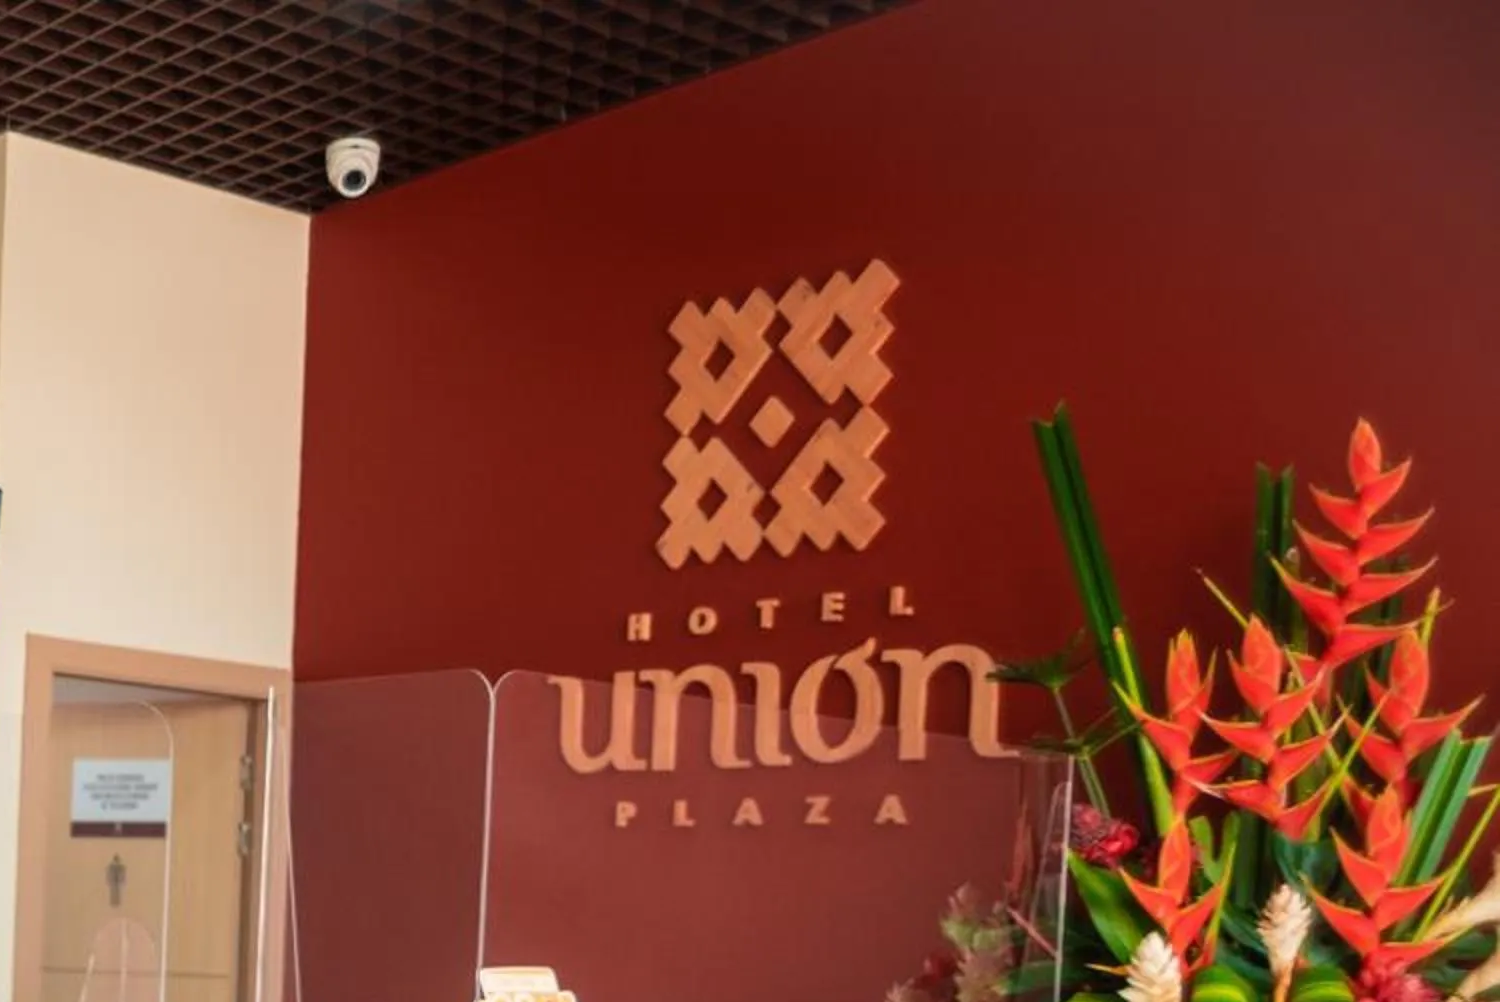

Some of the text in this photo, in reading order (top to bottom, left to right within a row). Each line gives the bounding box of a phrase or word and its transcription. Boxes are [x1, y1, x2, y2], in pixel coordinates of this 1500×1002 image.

[627, 586, 914, 642] HOTEL
[548, 637, 1021, 774] unión
[614, 795, 908, 827] PLAZA
